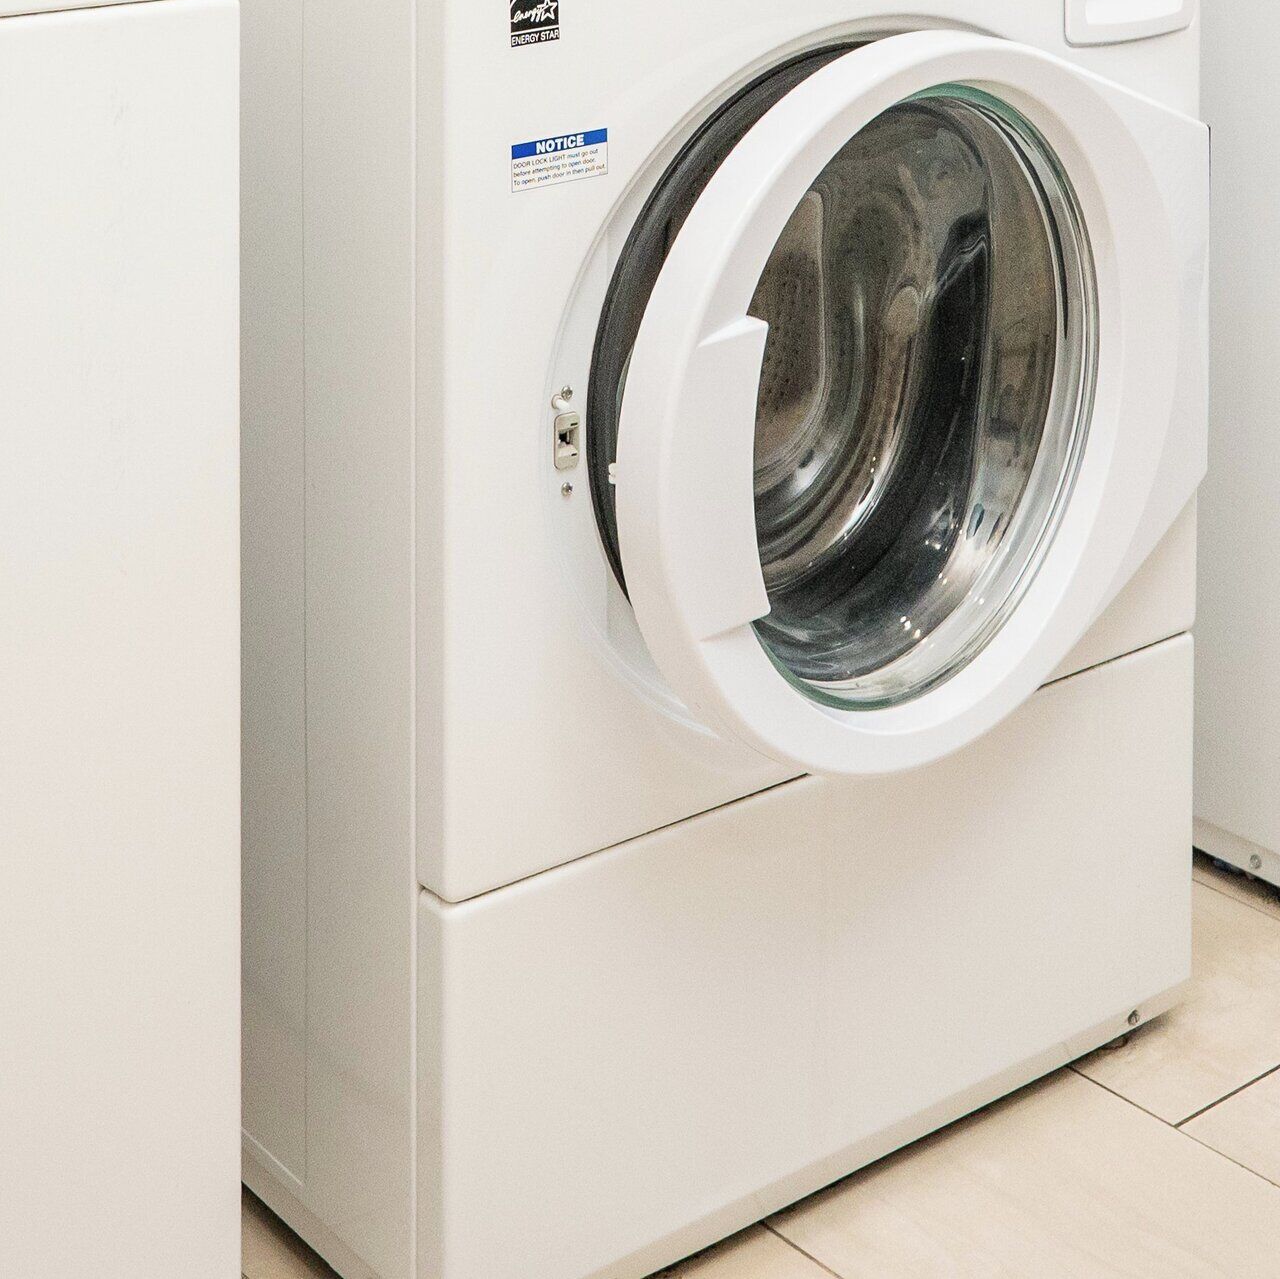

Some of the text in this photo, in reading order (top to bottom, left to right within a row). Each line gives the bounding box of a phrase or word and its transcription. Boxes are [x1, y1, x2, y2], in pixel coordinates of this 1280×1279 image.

[511, 30, 559, 46] ENERGY STAR
[536, 134, 584, 154] NOTICE
[514, 161, 530, 169] DOOR
[532, 158, 548, 166] LOCK
[549, 155, 565, 163] LIGHT
[514, 170, 530, 178] before
[532, 165, 560, 173] attempting
[538, 174, 551, 182] push
[585, 165, 595, 173] pull
